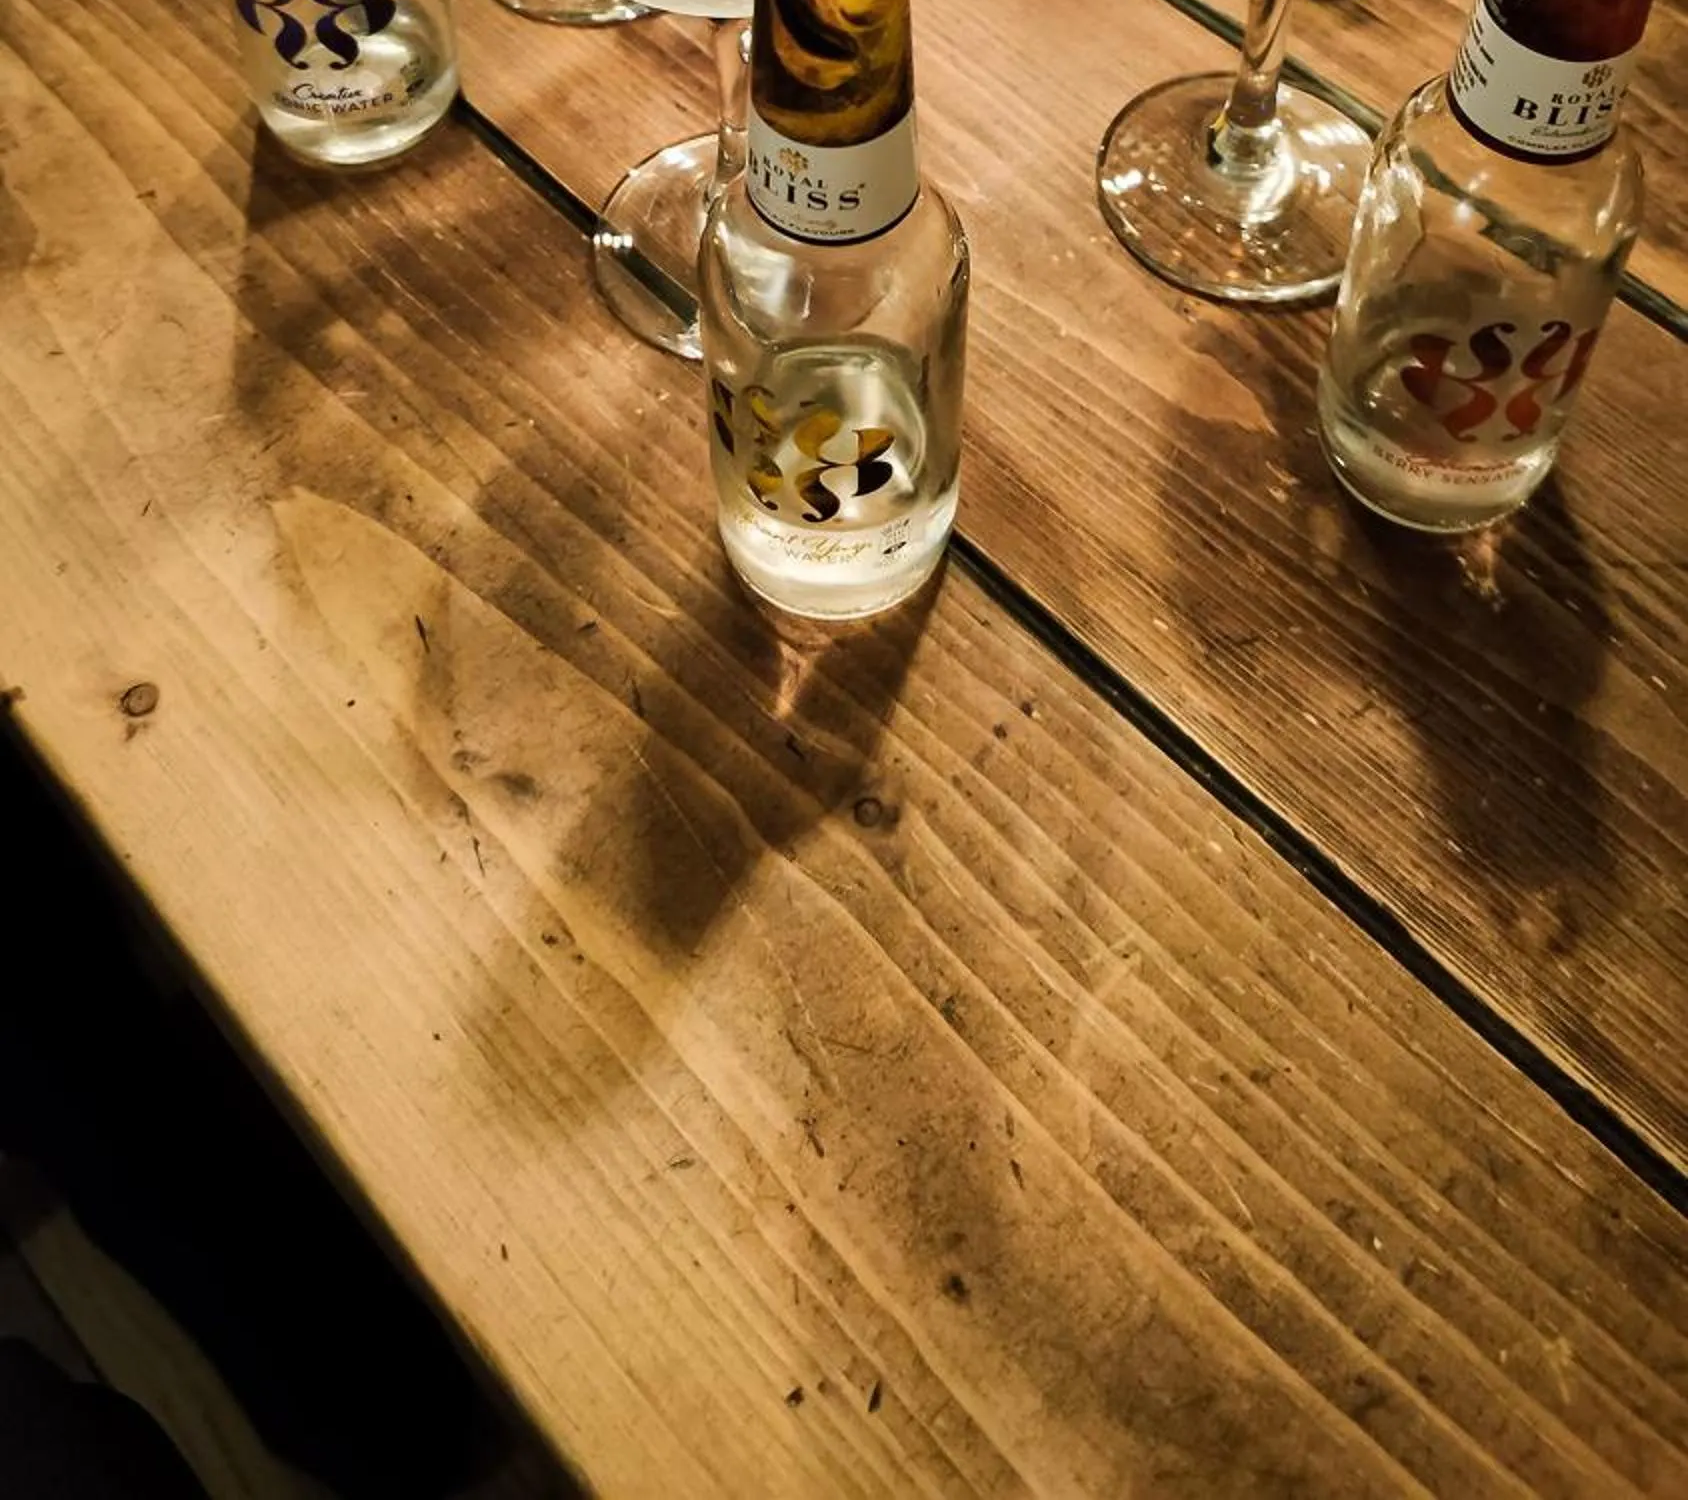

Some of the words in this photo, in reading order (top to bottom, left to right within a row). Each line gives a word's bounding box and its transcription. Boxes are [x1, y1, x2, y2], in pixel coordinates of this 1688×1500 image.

[293, 83, 363, 100] Creative
[332, 92, 394, 113] WATER
[763, 155, 828, 189] ROYAL
